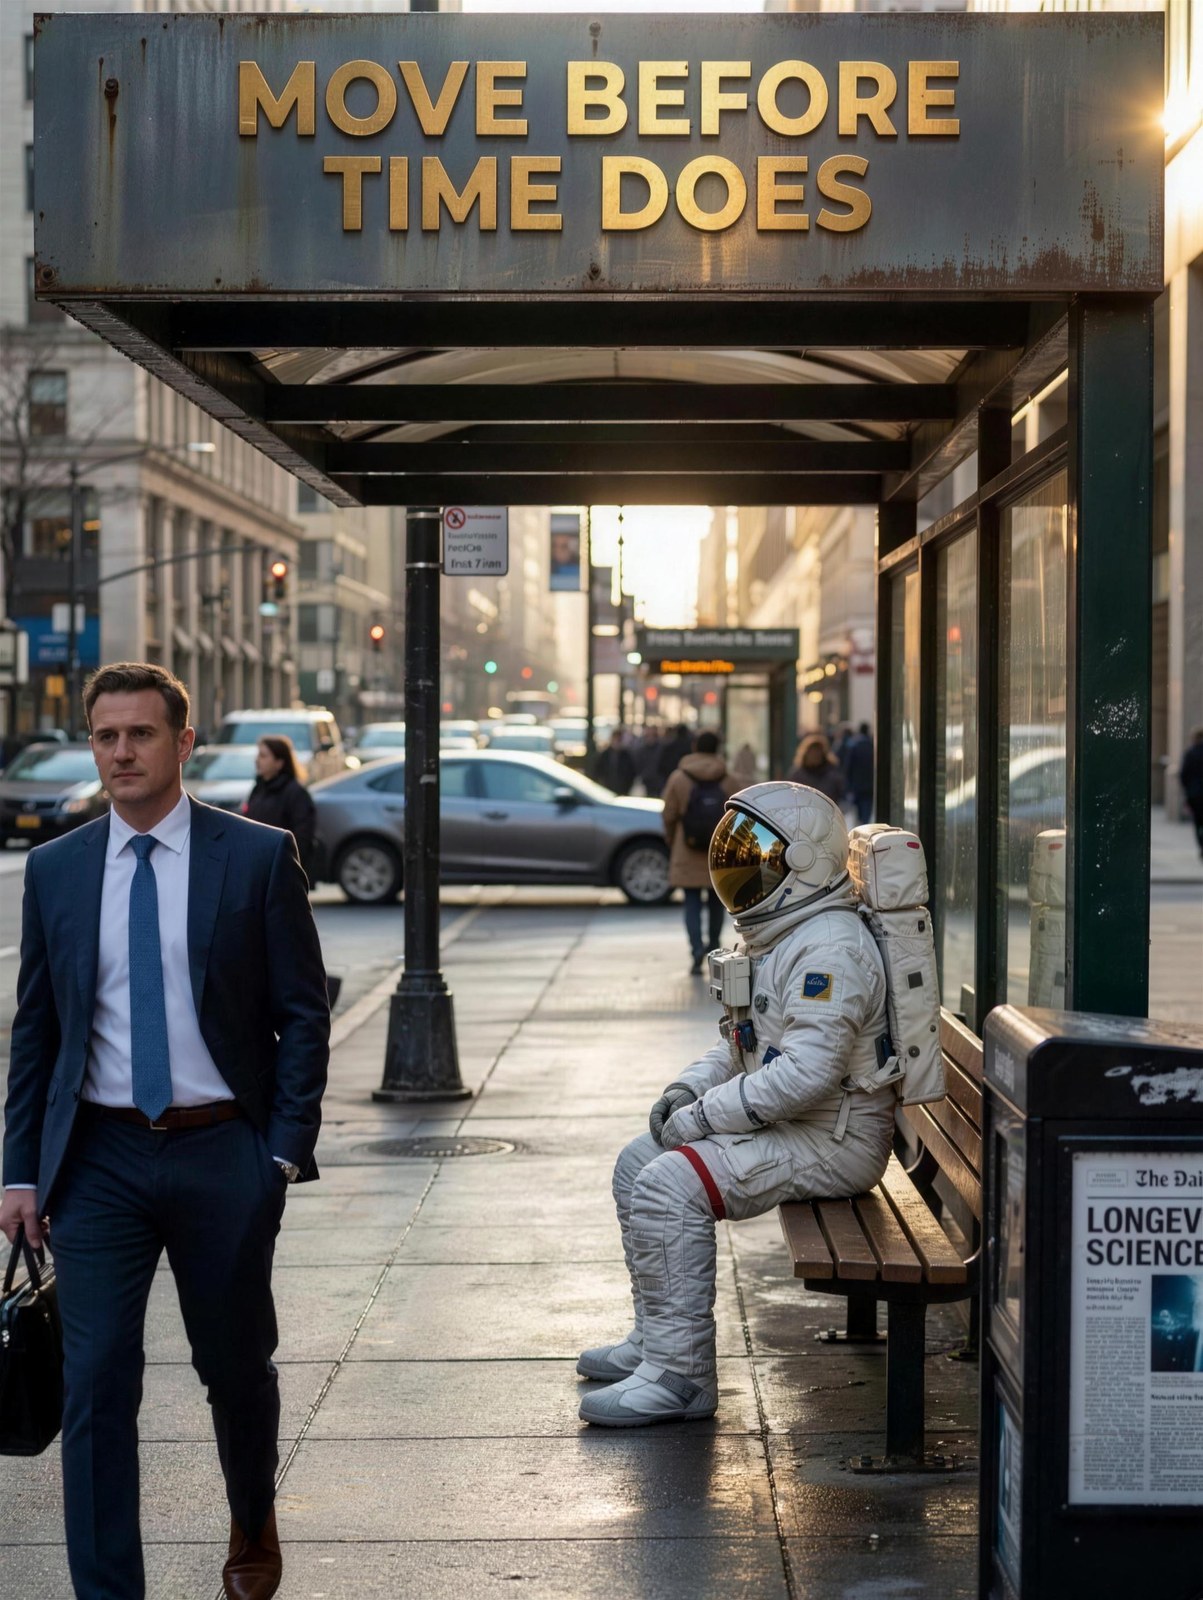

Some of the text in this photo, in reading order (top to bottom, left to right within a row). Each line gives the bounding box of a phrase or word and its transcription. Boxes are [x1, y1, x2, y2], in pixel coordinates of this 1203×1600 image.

[239, 59, 961, 136] MOVE BEFORE
[323, 154, 872, 232] TIME DOES
[1136, 1169, 1169, 1187] The
[1088, 1206, 1202, 1234] LONGEV
